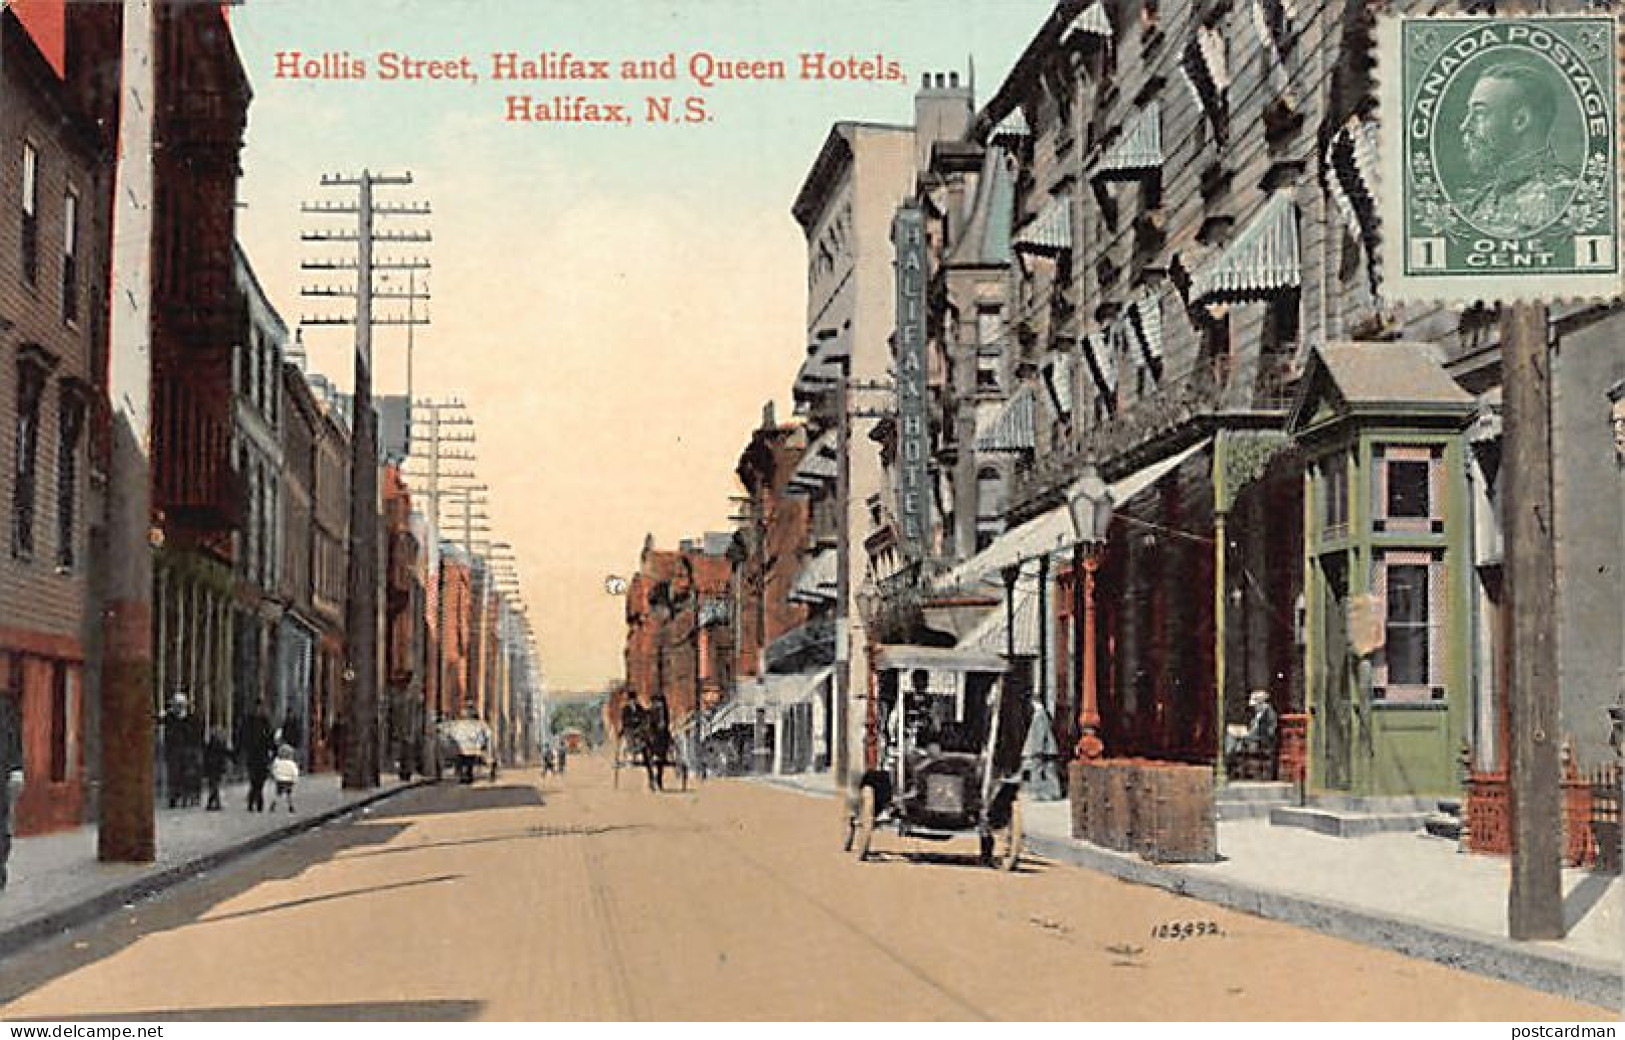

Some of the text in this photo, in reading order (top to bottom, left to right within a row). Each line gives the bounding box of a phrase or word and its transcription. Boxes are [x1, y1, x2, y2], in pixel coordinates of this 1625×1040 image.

[1413, 27, 1606, 139] CANADA POSTAGE
[1423, 241, 1433, 265] 1
[1473, 238, 1544, 251] ONE
[1587, 238, 1599, 263] 1
[1465, 252, 1555, 267] CENT
[903, 226, 921, 539] HALIFAX HOTEL
